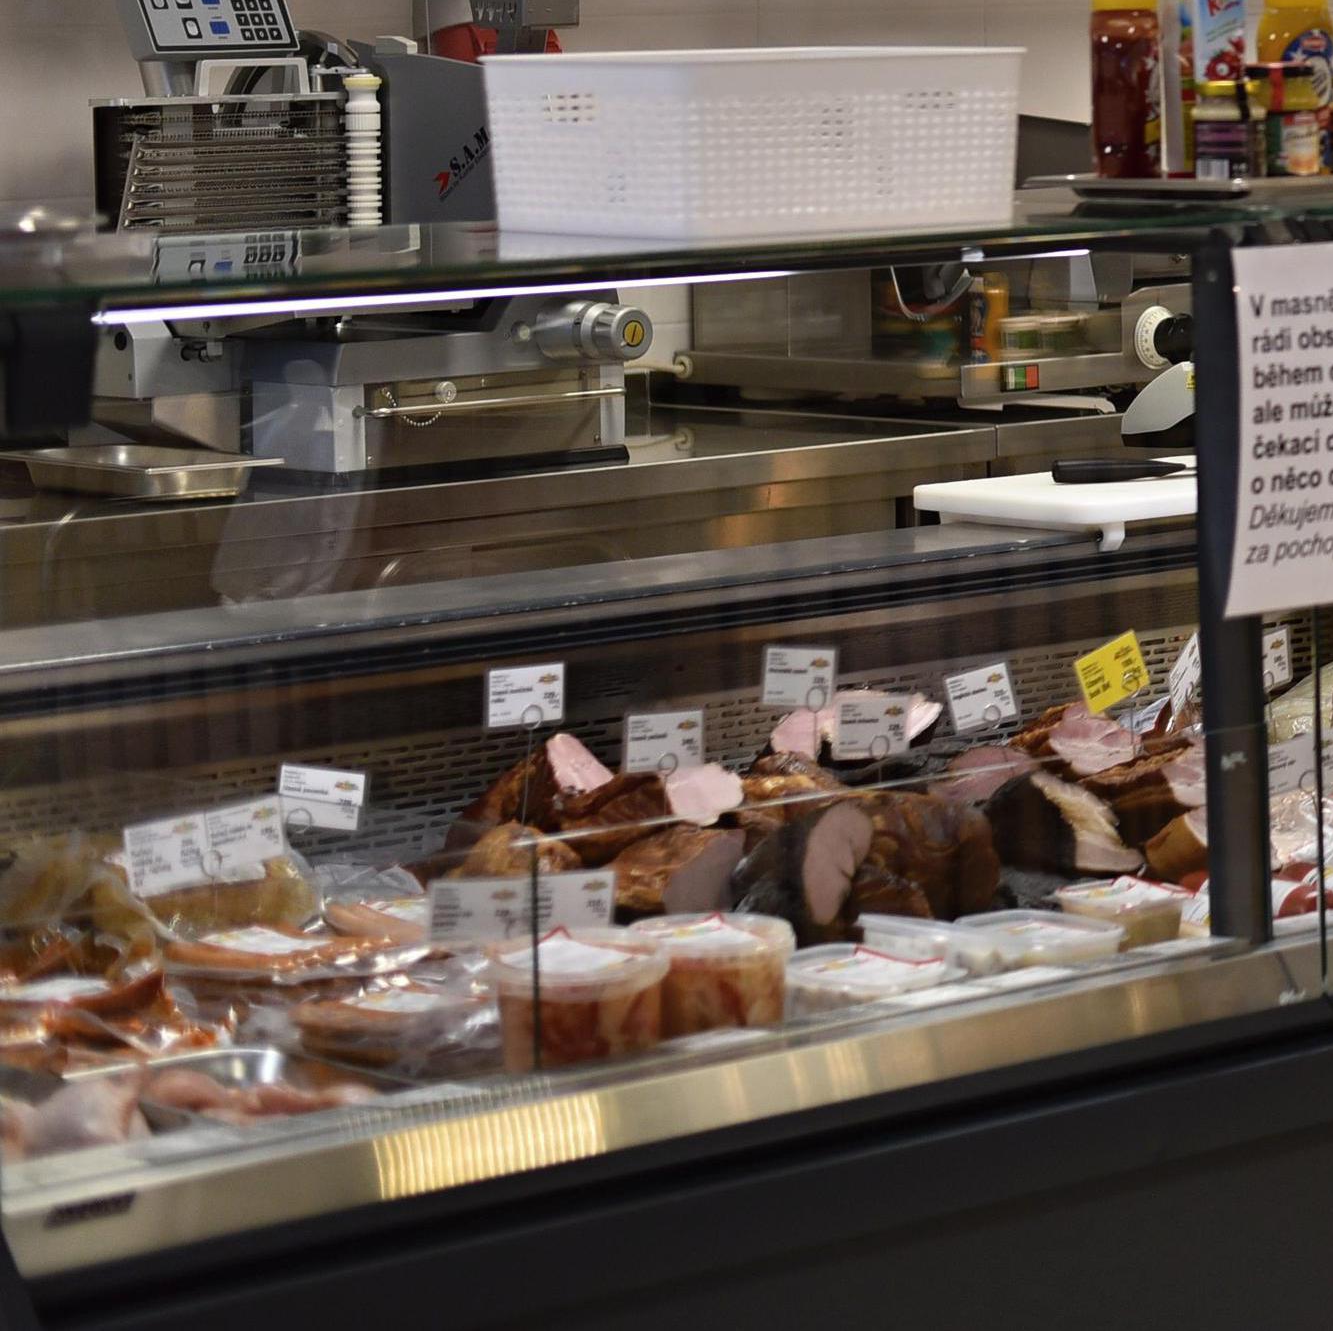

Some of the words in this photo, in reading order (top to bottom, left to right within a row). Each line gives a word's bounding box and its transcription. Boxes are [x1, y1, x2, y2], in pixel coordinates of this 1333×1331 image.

[1249, 293, 1265, 317] V
[1251, 327, 1292, 354] rádi
[1252, 360, 1324, 390] během
[1252, 400, 1284, 425] ale
[1252, 428, 1320, 460] čekací
[1250, 478, 1265, 495] o
[1270, 467, 1323, 492] něco
[1244, 544, 1269, 565] za
